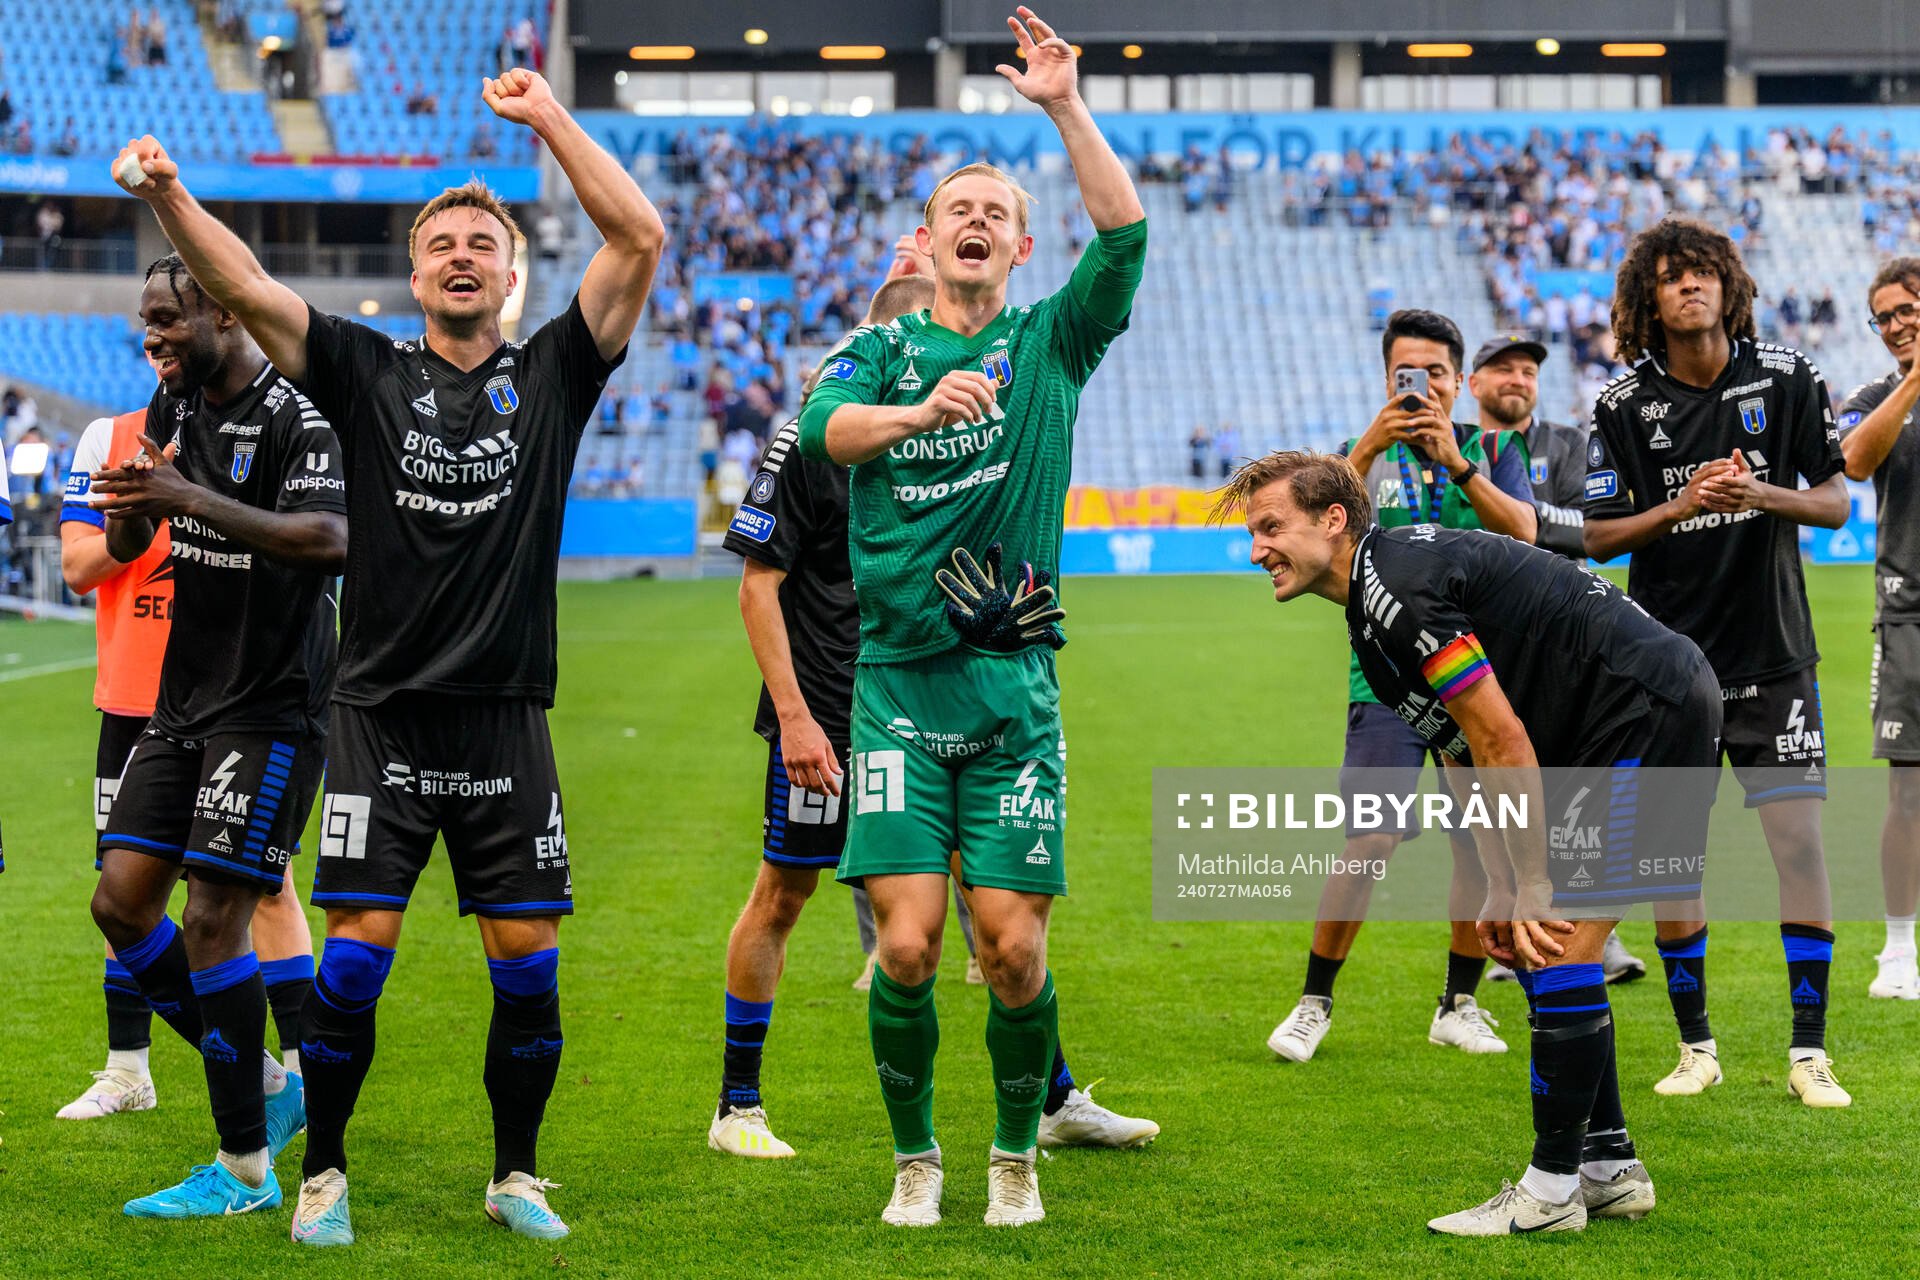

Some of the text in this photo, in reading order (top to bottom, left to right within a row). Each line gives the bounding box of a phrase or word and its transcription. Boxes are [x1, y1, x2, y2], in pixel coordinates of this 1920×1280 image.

[891, 461, 1011, 502] TOYO TIRES
[395, 489, 459, 515] TOYO
[420, 769, 471, 781] UPPLANDS
[420, 776, 513, 798] BILFORUM
[203, 809, 246, 827] TELE DATA
[1013, 820, 1031, 830] TELE
[1037, 823, 1056, 832] DATA
[207, 842, 234, 855] SELECT
[1025, 855, 1052, 865] SELECT
[1559, 851, 1575, 861] TELE
[1581, 850, 1602, 860] DATA
[1567, 880, 1595, 888] SELECT
